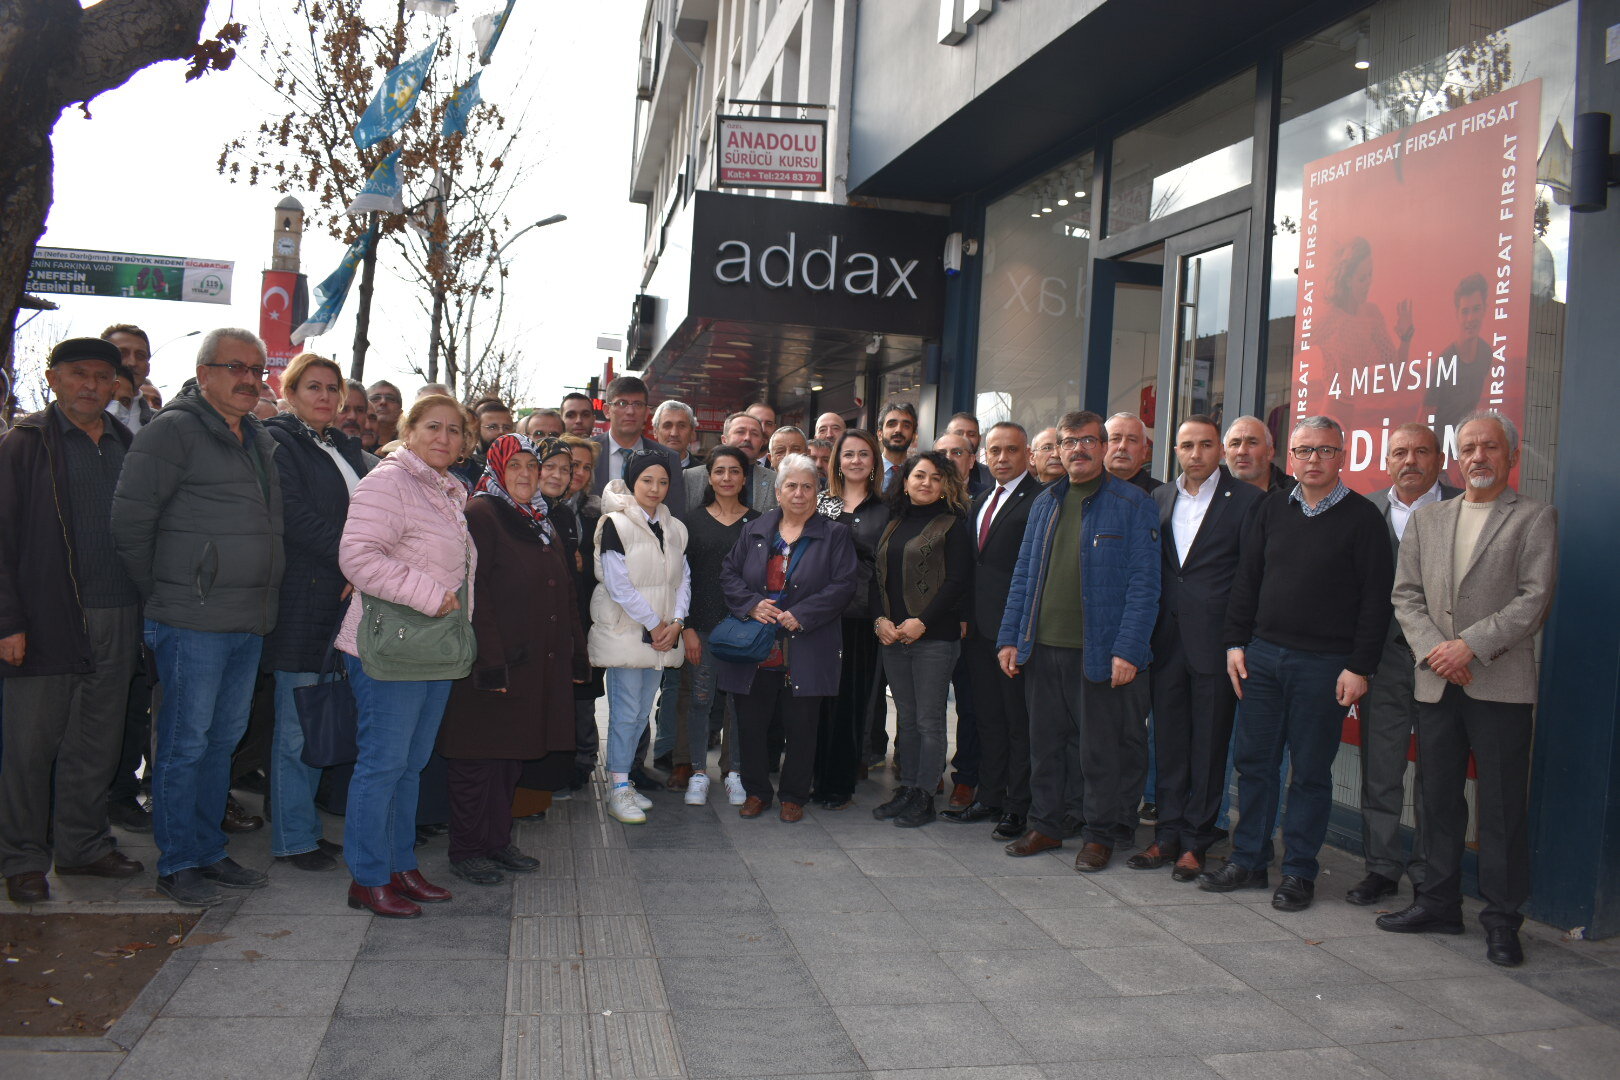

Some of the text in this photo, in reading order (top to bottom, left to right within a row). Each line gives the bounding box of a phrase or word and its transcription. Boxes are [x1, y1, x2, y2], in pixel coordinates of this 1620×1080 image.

[725, 149, 818, 169] SÜRÜCÜ KURSU
[727, 131, 817, 152] ANADOLU
[1310, 100, 1519, 188] FIRSAT FIRSAT FIRSAT FIRSAT
[727, 170, 750, 179] Kat:4
[759, 171, 790, 181] Tel:224
[792, 173, 803, 181] 83
[805, 173, 817, 181] 70
[1500, 134, 1518, 221] FIRSAT
[37, 270, 87, 282] NEFESİN
[715, 231, 920, 300] addax
[1494, 232, 1513, 320] FIRSAT
[1296, 198, 1319, 420] IRSAT FIRSAT FIRSAT
[1327, 351, 1458, 400] 4 MEVSİM
